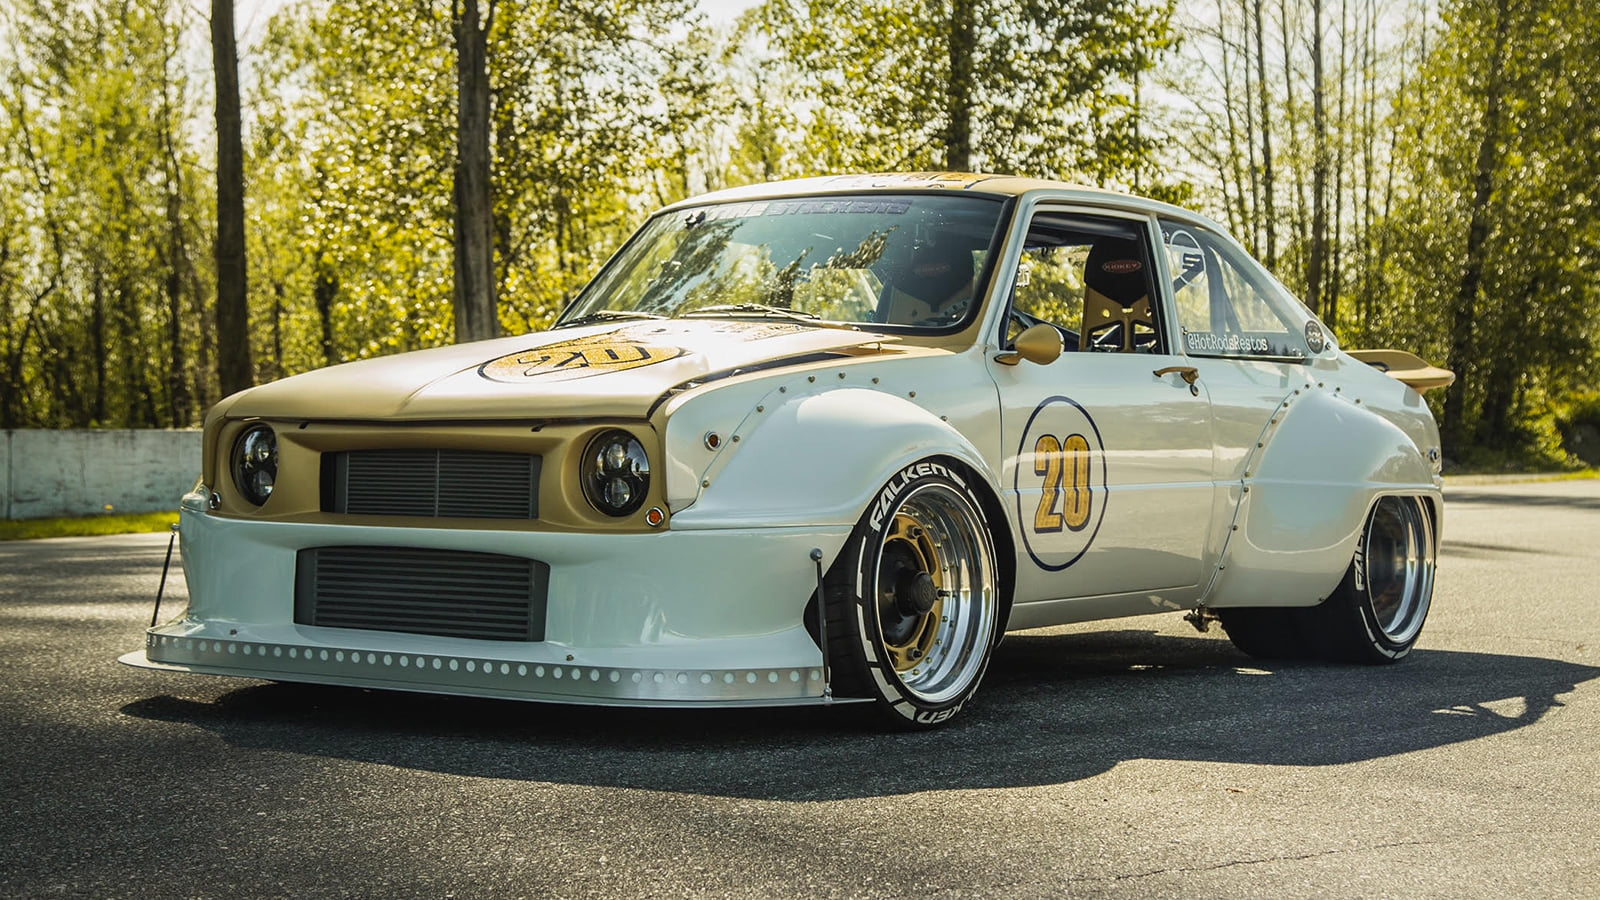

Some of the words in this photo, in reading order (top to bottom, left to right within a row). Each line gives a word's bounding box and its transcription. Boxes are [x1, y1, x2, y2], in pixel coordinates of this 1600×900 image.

[1187, 334, 1269, 351] @HotRodsRestos
[869, 463, 948, 532] FALKEN
[1034, 433, 1092, 534] 20
